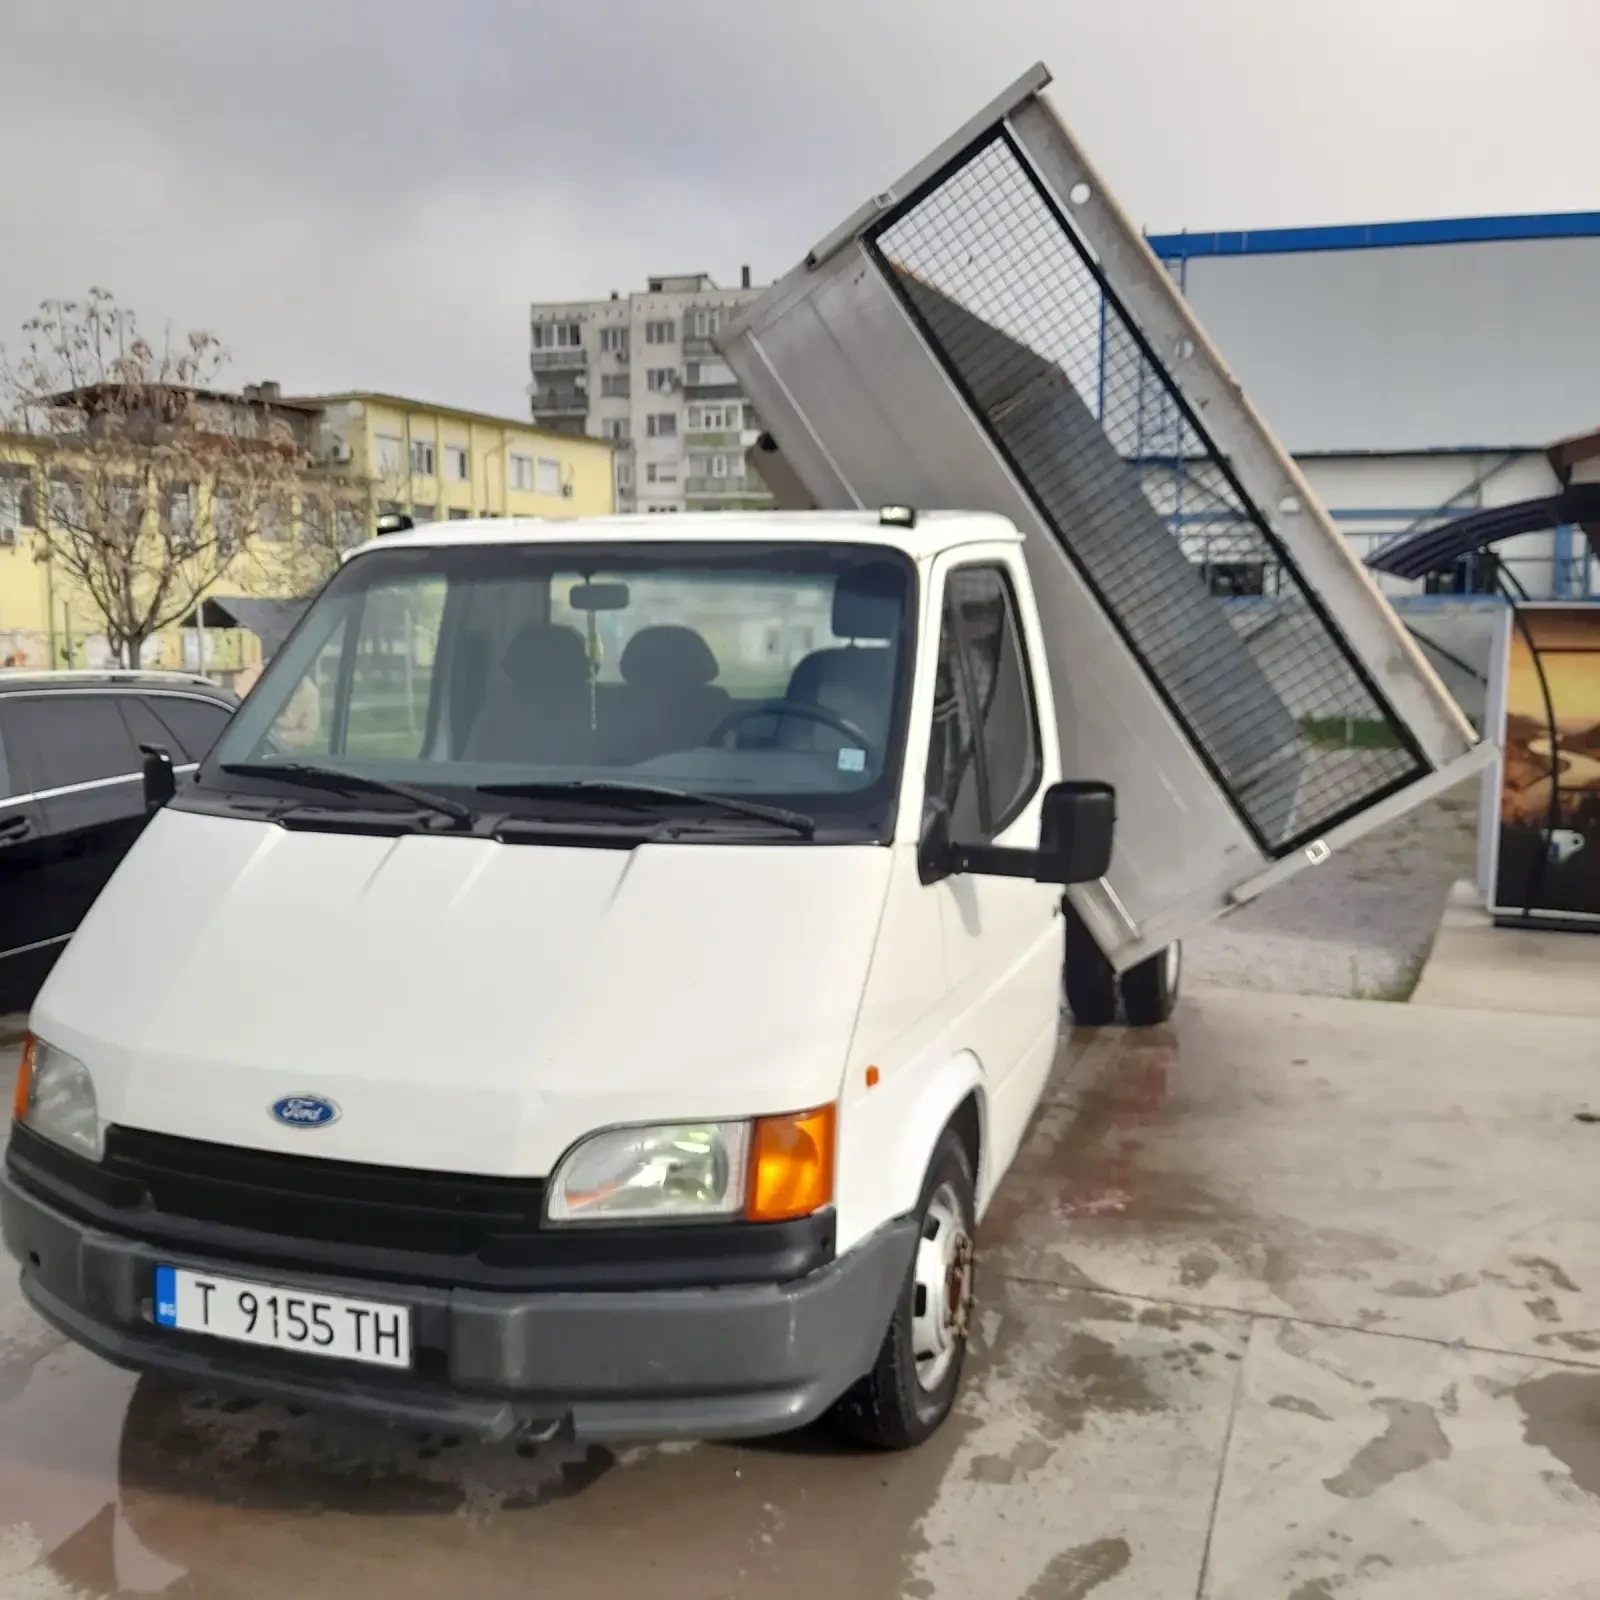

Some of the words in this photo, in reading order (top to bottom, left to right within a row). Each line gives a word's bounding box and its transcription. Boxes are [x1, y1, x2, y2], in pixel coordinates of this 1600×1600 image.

[282, 1099, 323, 1121] Ford
[195, 1281, 216, 1325] T
[238, 1291, 334, 1346] 9155
[346, 1307, 399, 1358] TH
